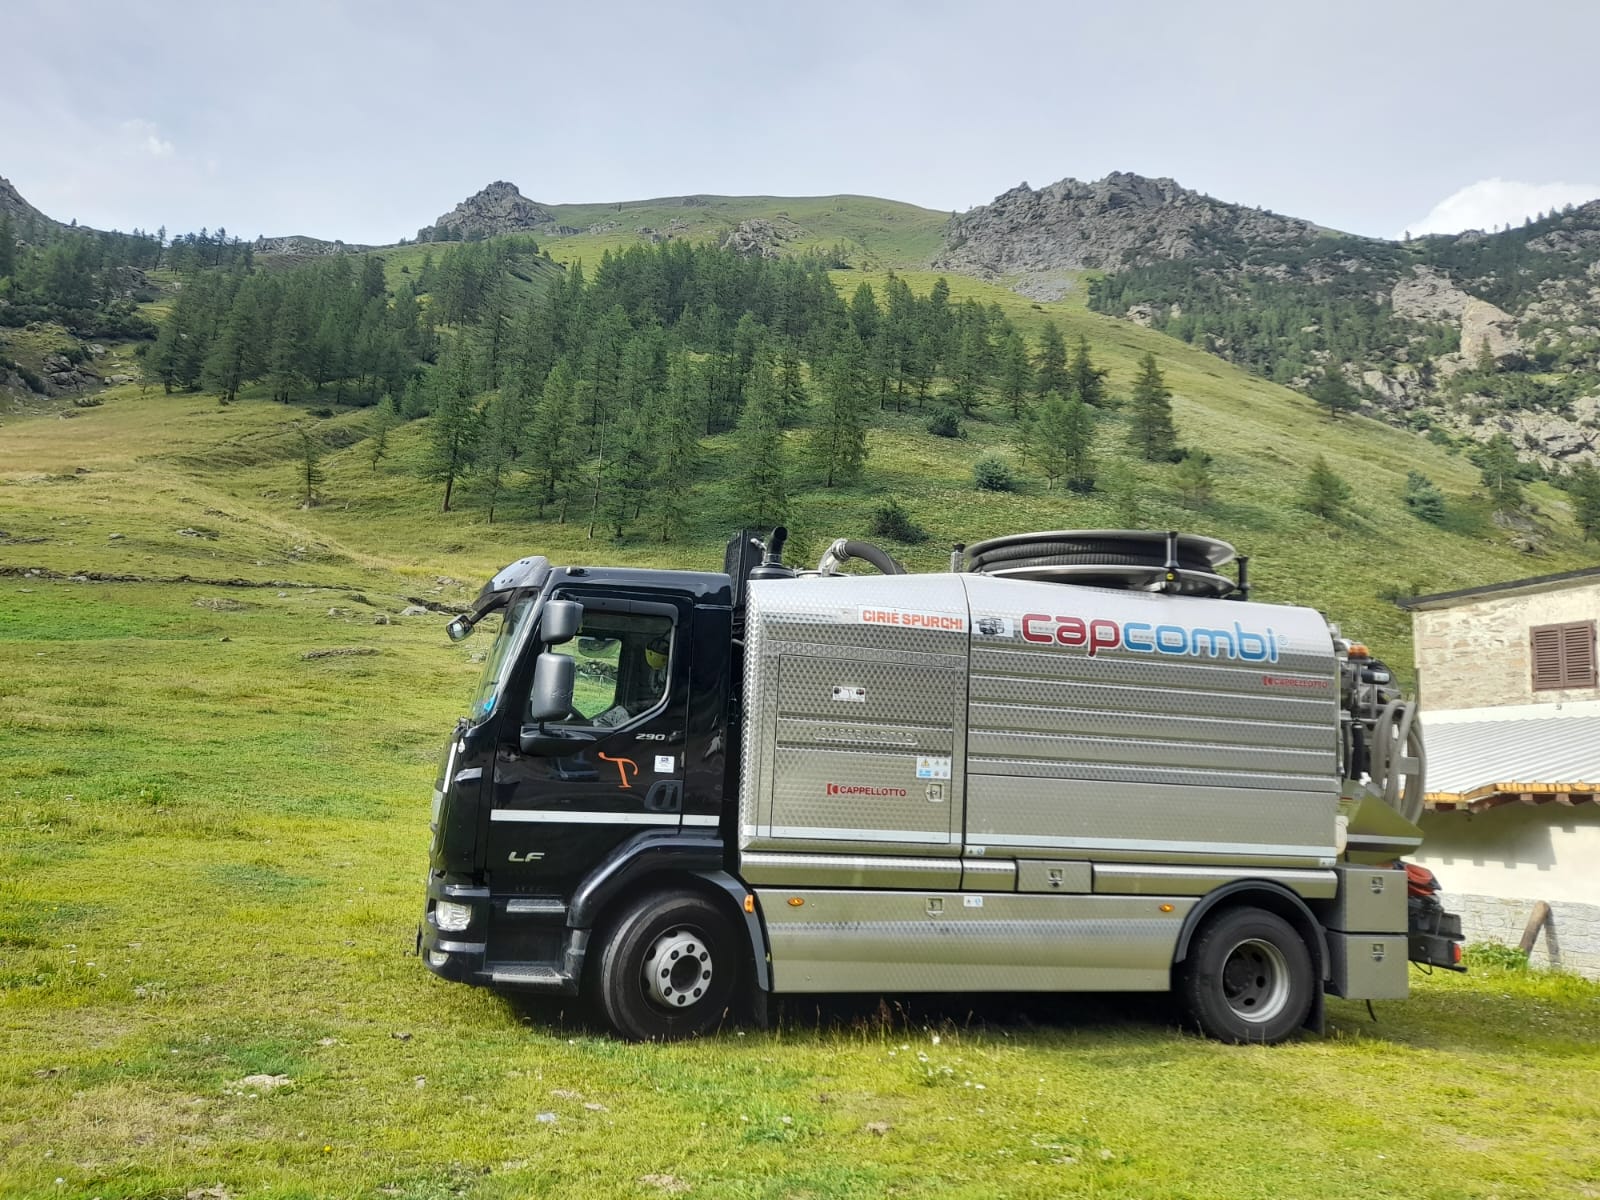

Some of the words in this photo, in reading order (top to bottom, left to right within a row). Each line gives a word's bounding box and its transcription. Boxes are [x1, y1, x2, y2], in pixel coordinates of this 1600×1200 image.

[901, 613, 963, 630] SPURGHI
[1022, 613, 1278, 663] capcombi
[635, 733, 666, 741] 290
[840, 785, 907, 797] CAPPELLOTTO
[508, 851, 545, 862] LF
